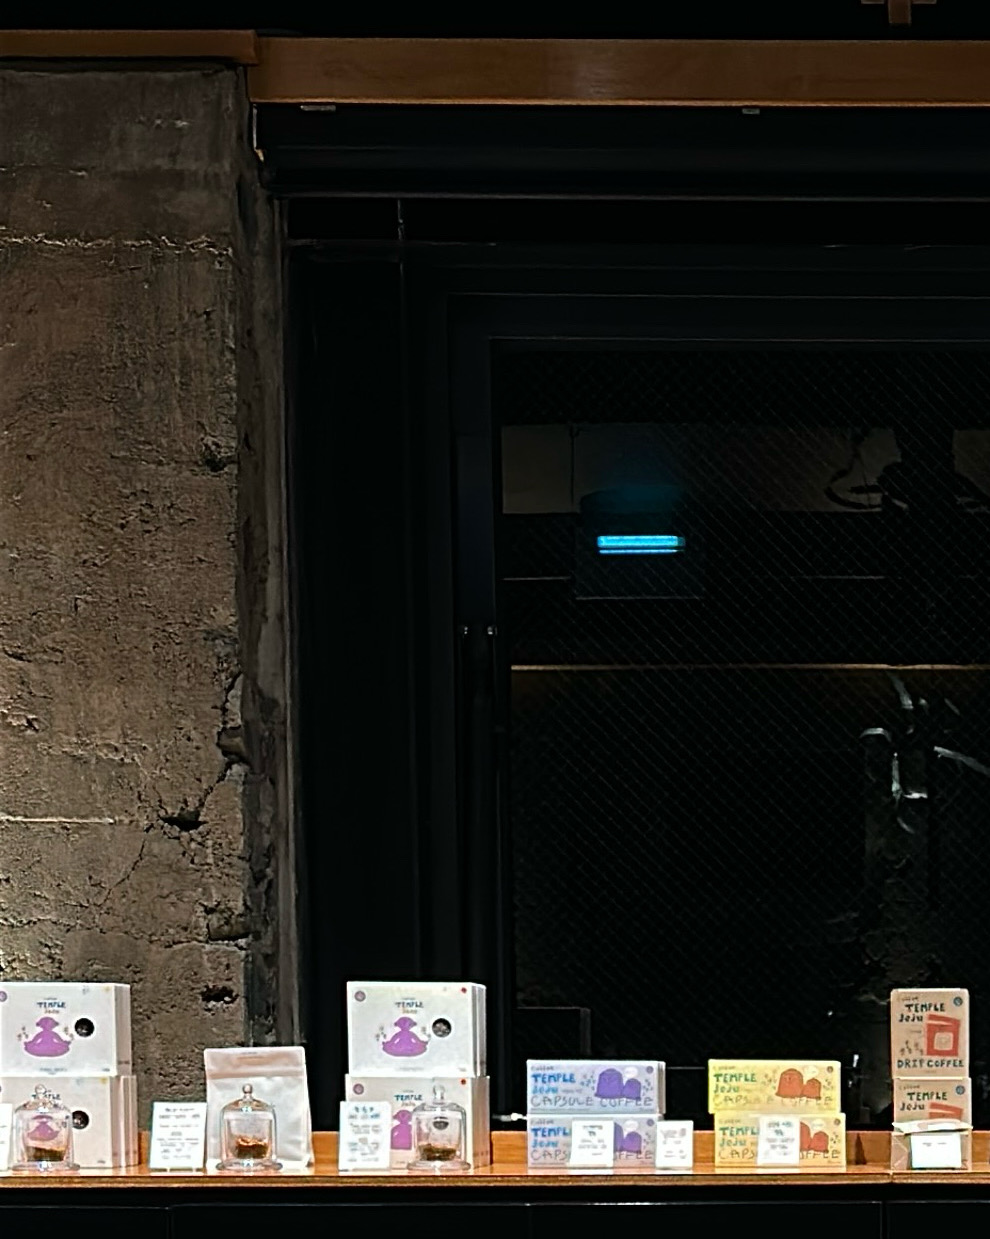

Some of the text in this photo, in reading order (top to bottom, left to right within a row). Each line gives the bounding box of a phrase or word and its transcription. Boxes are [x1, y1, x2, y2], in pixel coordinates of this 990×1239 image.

[904, 1003, 945, 1013] TEMPLE
[896, 1059, 965, 1069] DRIP COFFEE
[531, 1073, 576, 1084] TEMPLE
[713, 1073, 757, 1083] TEMPLE
[906, 1091, 948, 1101] TEMPLE
[530, 1096, 653, 1108] CAPSULE COFFEE
[531, 1127, 571, 1138] TEMPL
[719, 1126, 760, 1137] TEMPL
